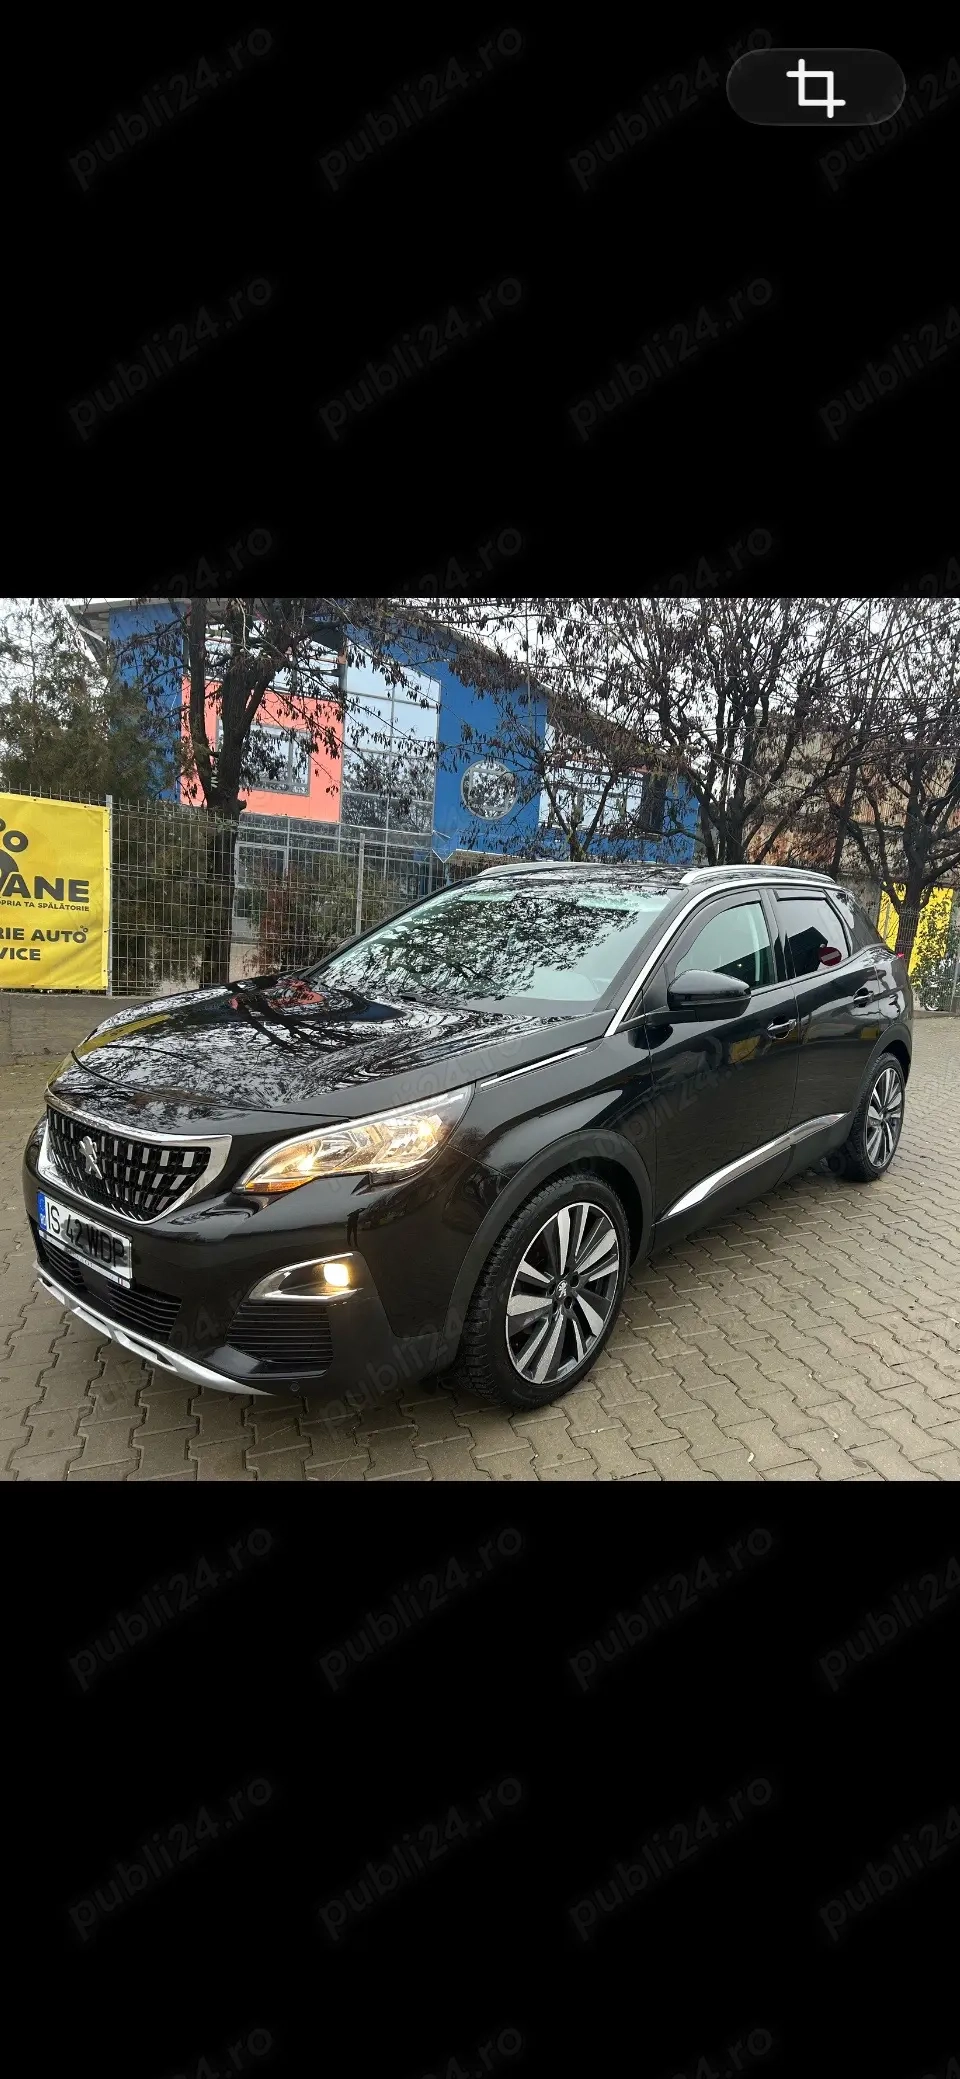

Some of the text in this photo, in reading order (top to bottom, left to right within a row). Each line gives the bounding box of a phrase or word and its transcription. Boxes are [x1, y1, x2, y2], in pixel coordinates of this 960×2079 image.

[31, 928, 87, 943] AUTO
[47, 1202, 60, 1235] IS
[66, 1214, 83, 1250] 42
